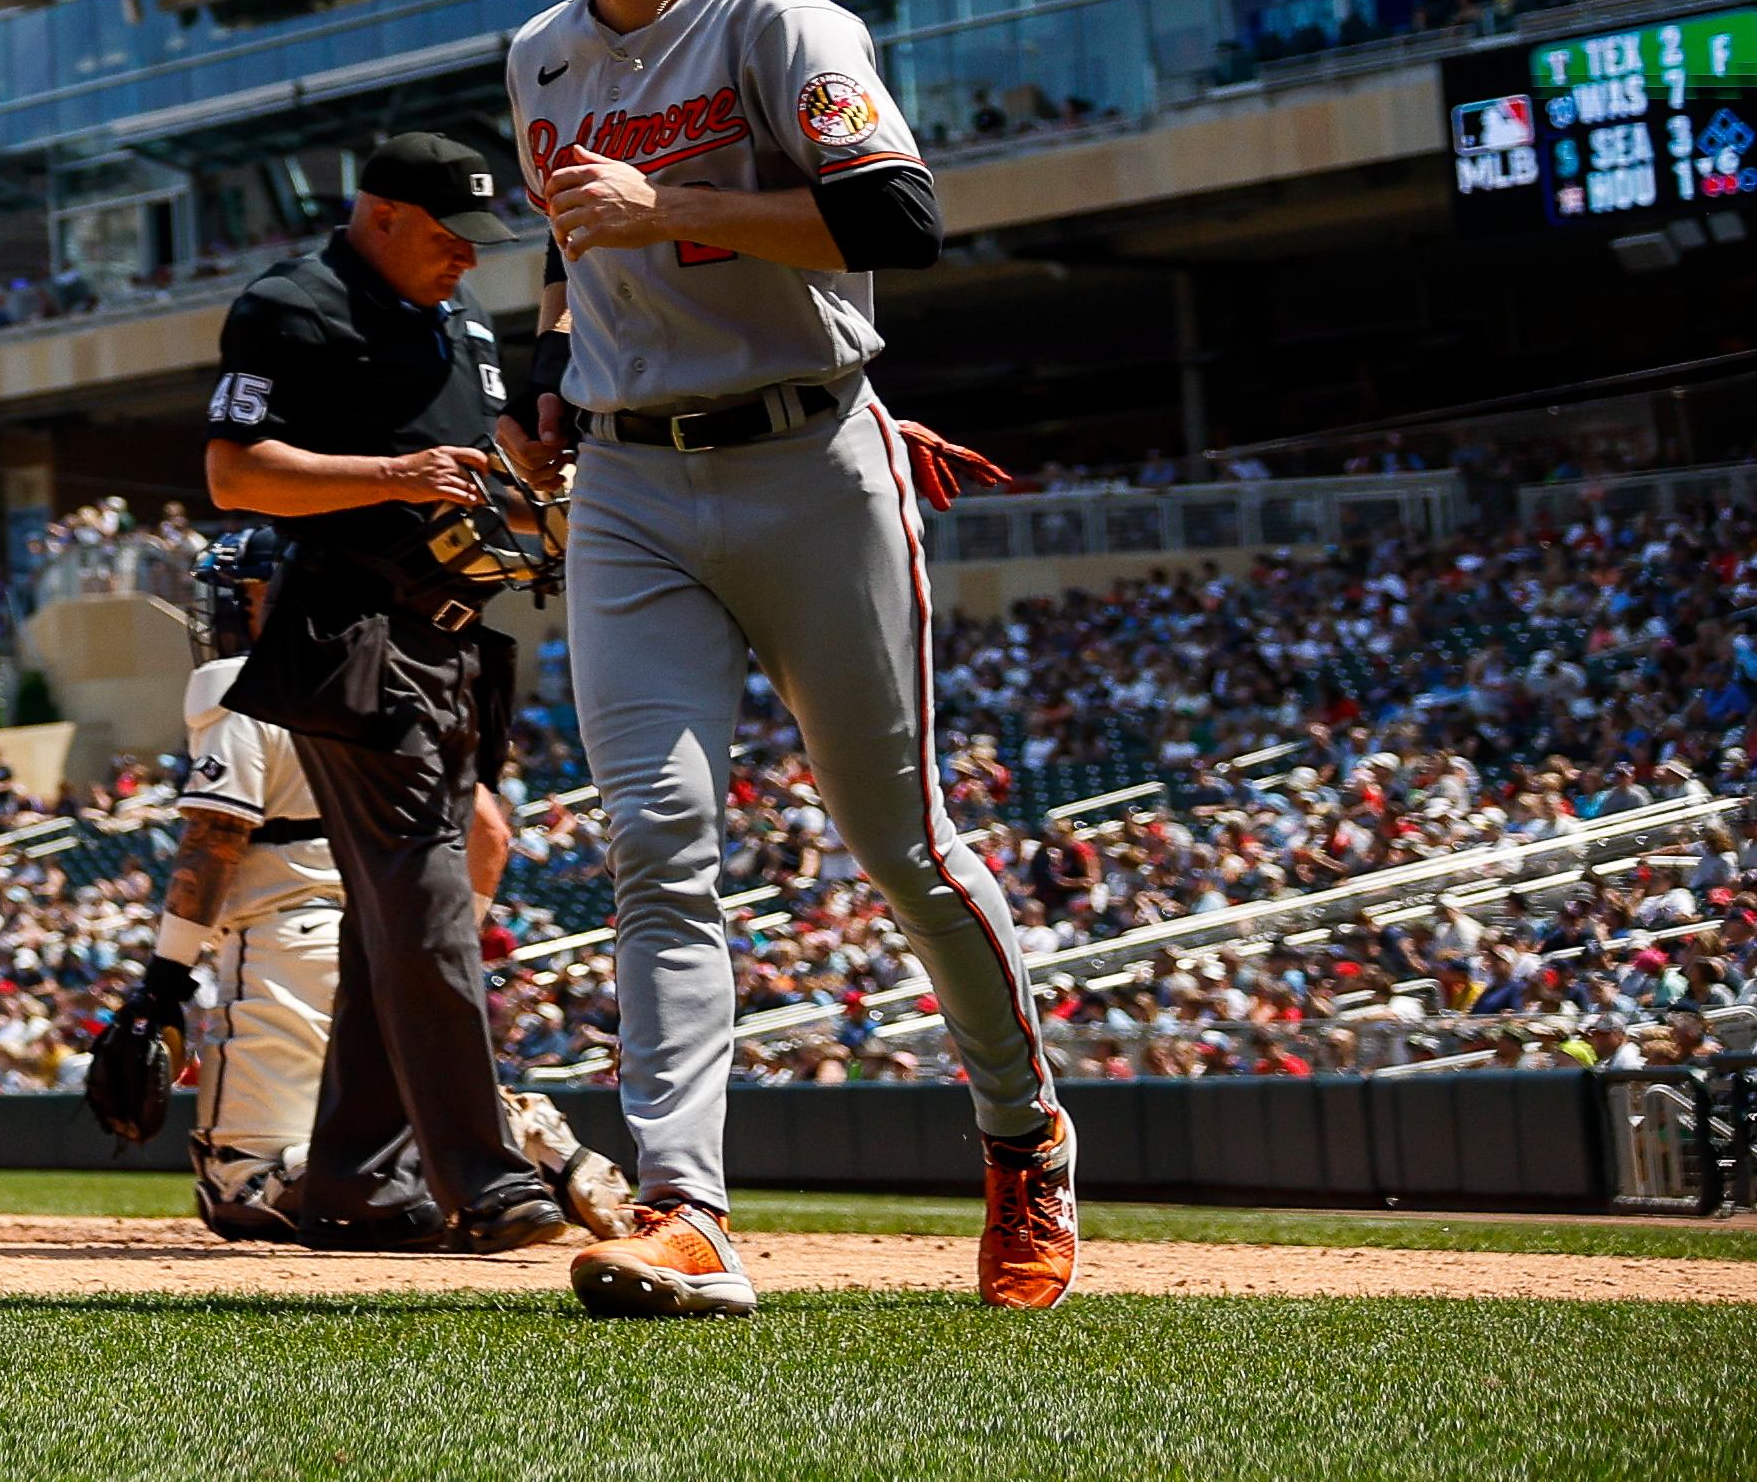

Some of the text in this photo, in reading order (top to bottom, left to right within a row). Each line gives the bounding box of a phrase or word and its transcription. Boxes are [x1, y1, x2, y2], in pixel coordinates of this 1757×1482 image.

[1657, 25, 1684, 66] 2
[1572, 68, 1686, 123] WAS 7
[1456, 148, 1540, 194] MLB
